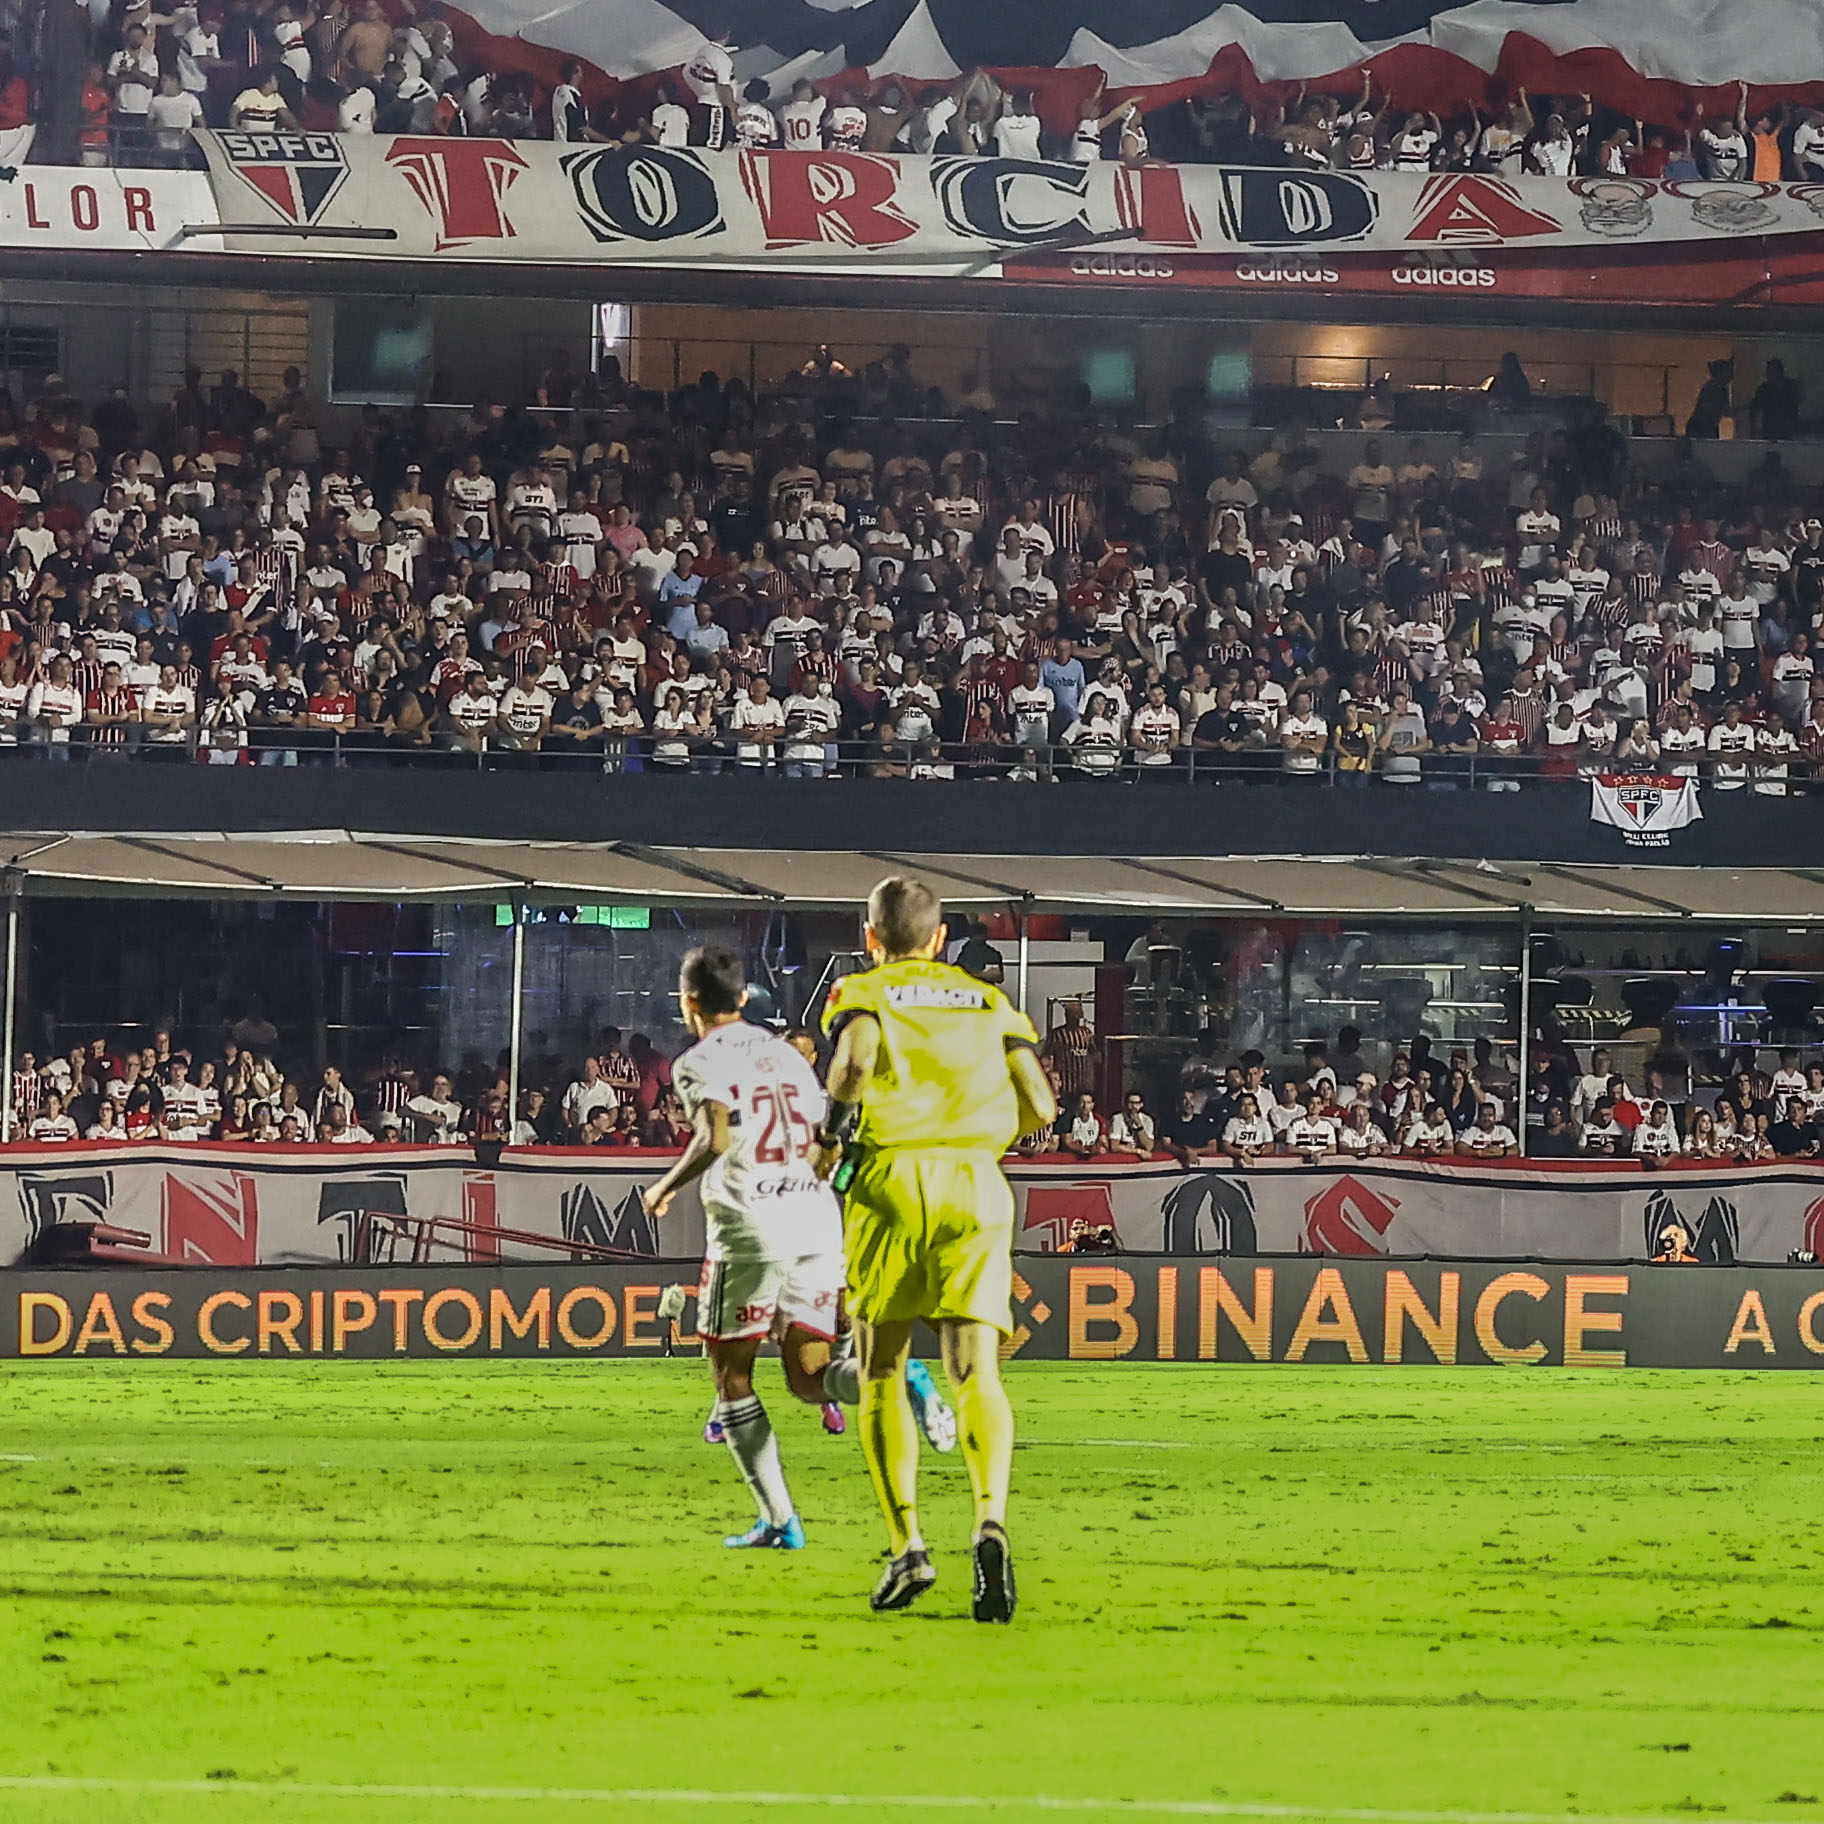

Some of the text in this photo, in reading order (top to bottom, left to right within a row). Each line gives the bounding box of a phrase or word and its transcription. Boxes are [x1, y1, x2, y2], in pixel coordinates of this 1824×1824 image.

[787, 118, 810, 140] 10
[223, 131, 338, 162] SPFC
[25, 183, 155, 232] LOR
[384, 136, 1566, 253] TORCIDA
[1071, 254, 1174, 278] adidas
[1235, 260, 1340, 284] adidas
[1391, 265, 1496, 287] adidas
[524, 494, 544, 504] STI
[1617, 789, 1660, 802] SPFC
[752, 1083, 814, 1164] 25
[1239, 1131, 1258, 1142] STI
[18, 1285, 700, 1356] DAS CRIPTOMOE
[1066, 1265, 1631, 1369] BINANCE
[1724, 1288, 1777, 1355] A
